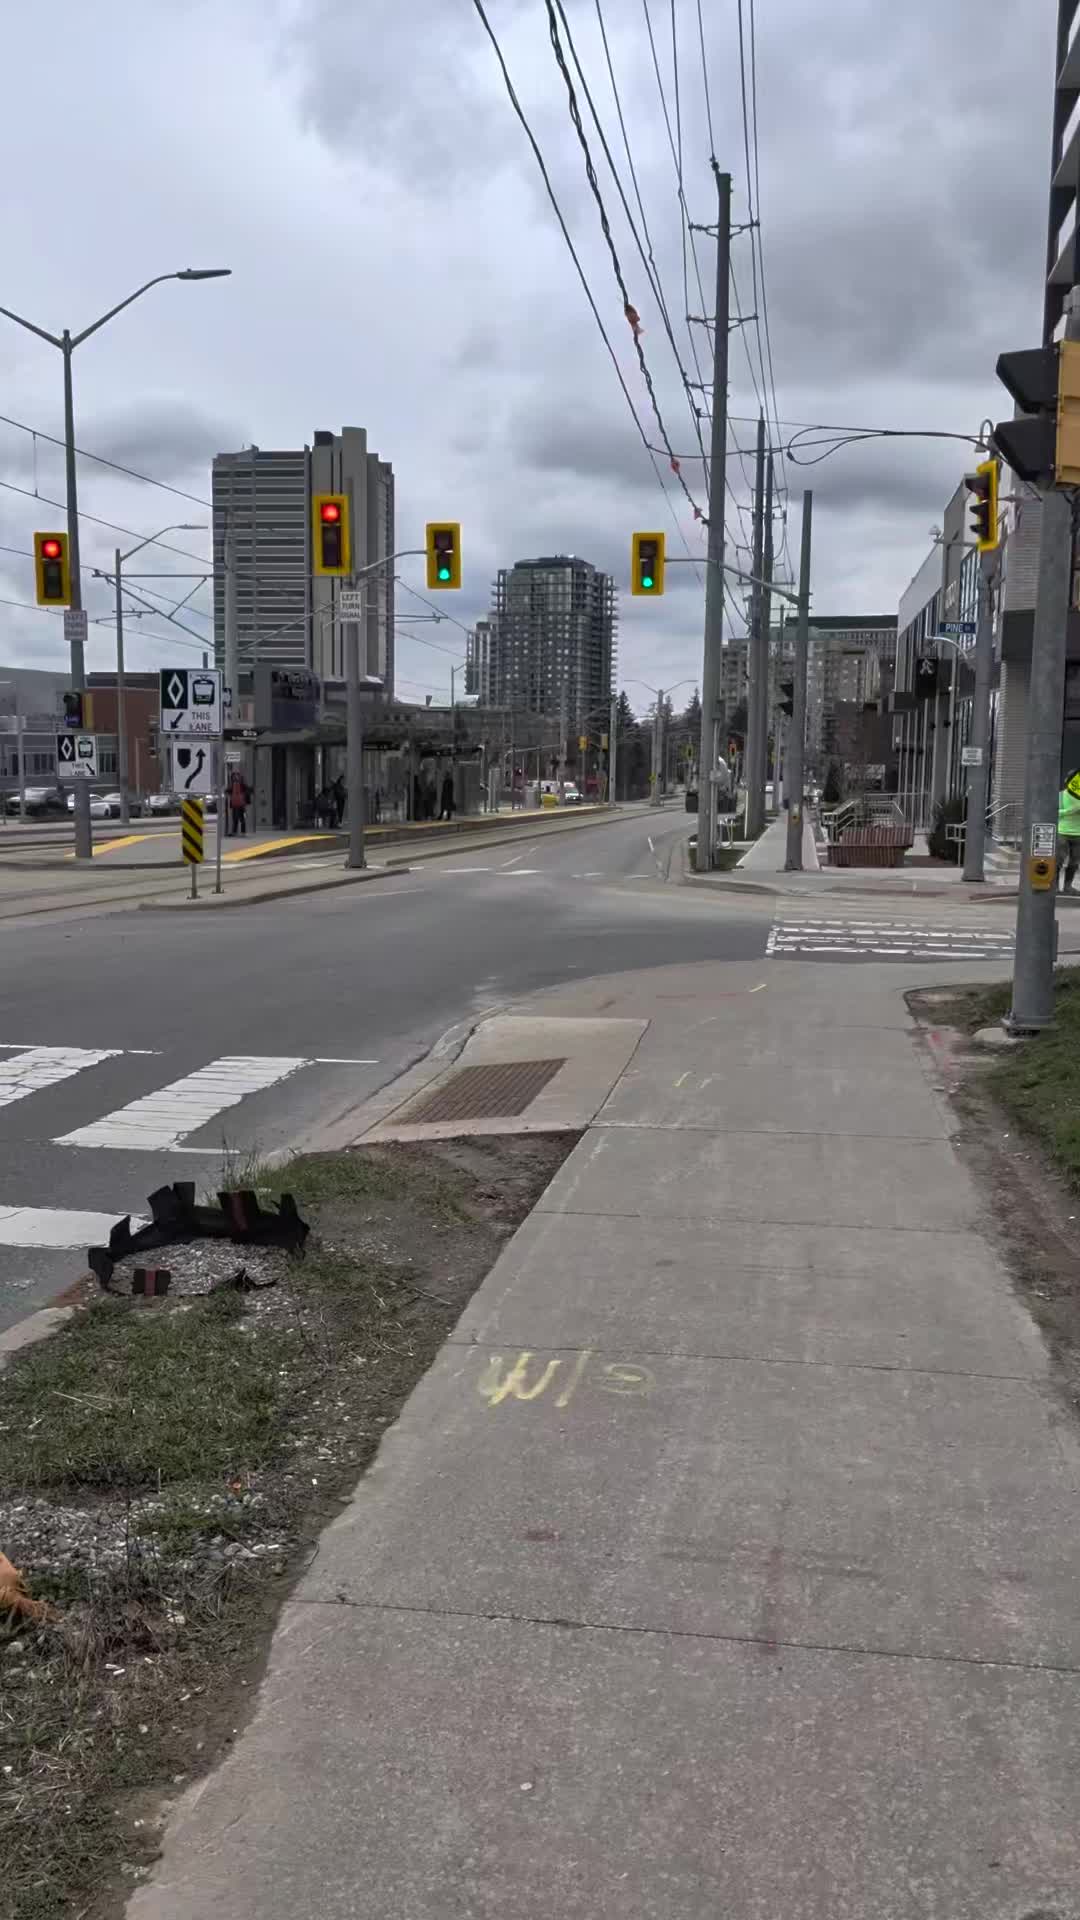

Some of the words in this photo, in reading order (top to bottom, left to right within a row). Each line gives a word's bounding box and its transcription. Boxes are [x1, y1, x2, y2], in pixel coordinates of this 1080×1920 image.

[945, 623, 964, 633] PINE
[191, 711, 210, 721] THIS
[190, 722, 212, 731] LANE
